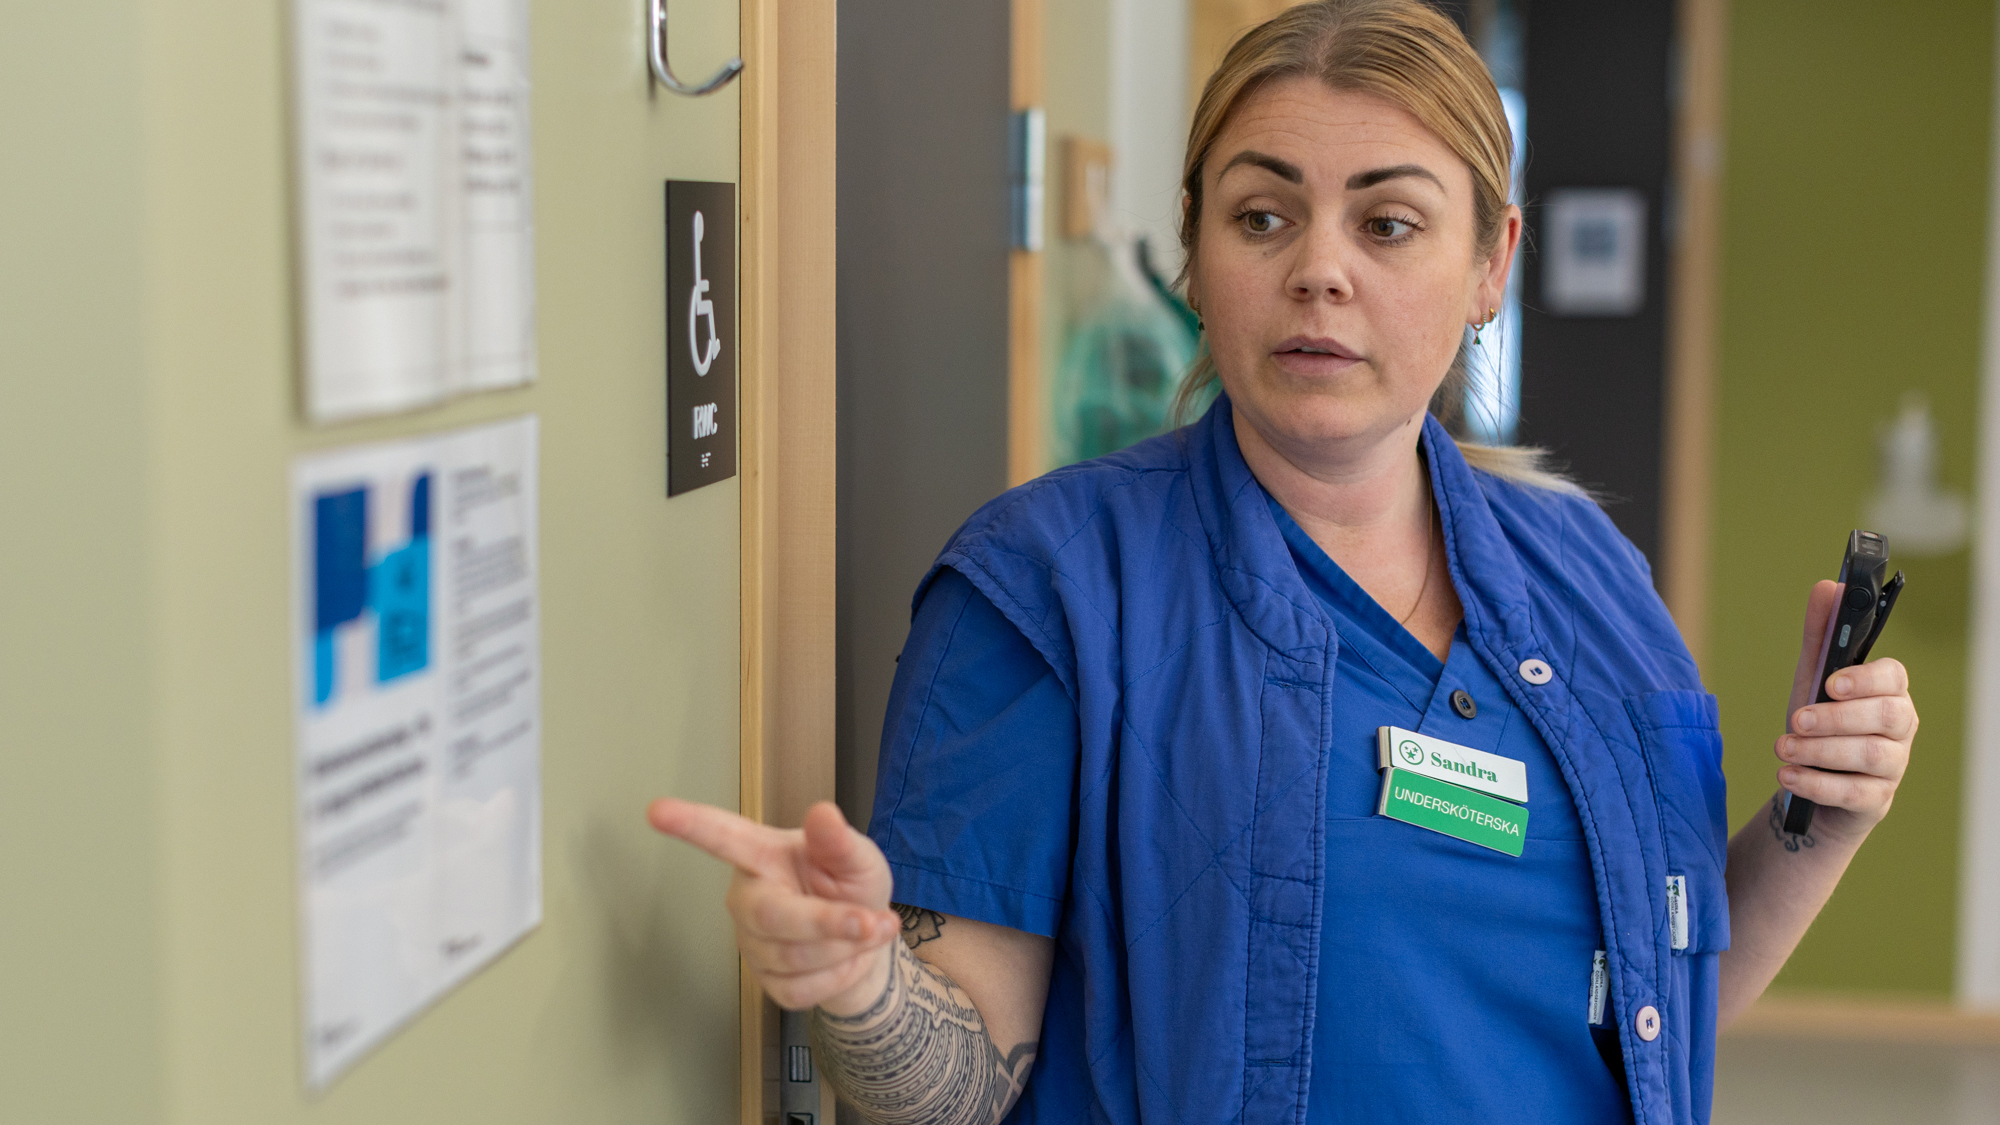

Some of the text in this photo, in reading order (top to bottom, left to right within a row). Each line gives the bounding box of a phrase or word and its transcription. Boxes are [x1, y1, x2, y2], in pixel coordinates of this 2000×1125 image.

[693, 402, 718, 440] RWC
[1430, 751, 1498, 783] Sandra
[1394, 786, 1519, 837] UNDERSKÖTERSKA
